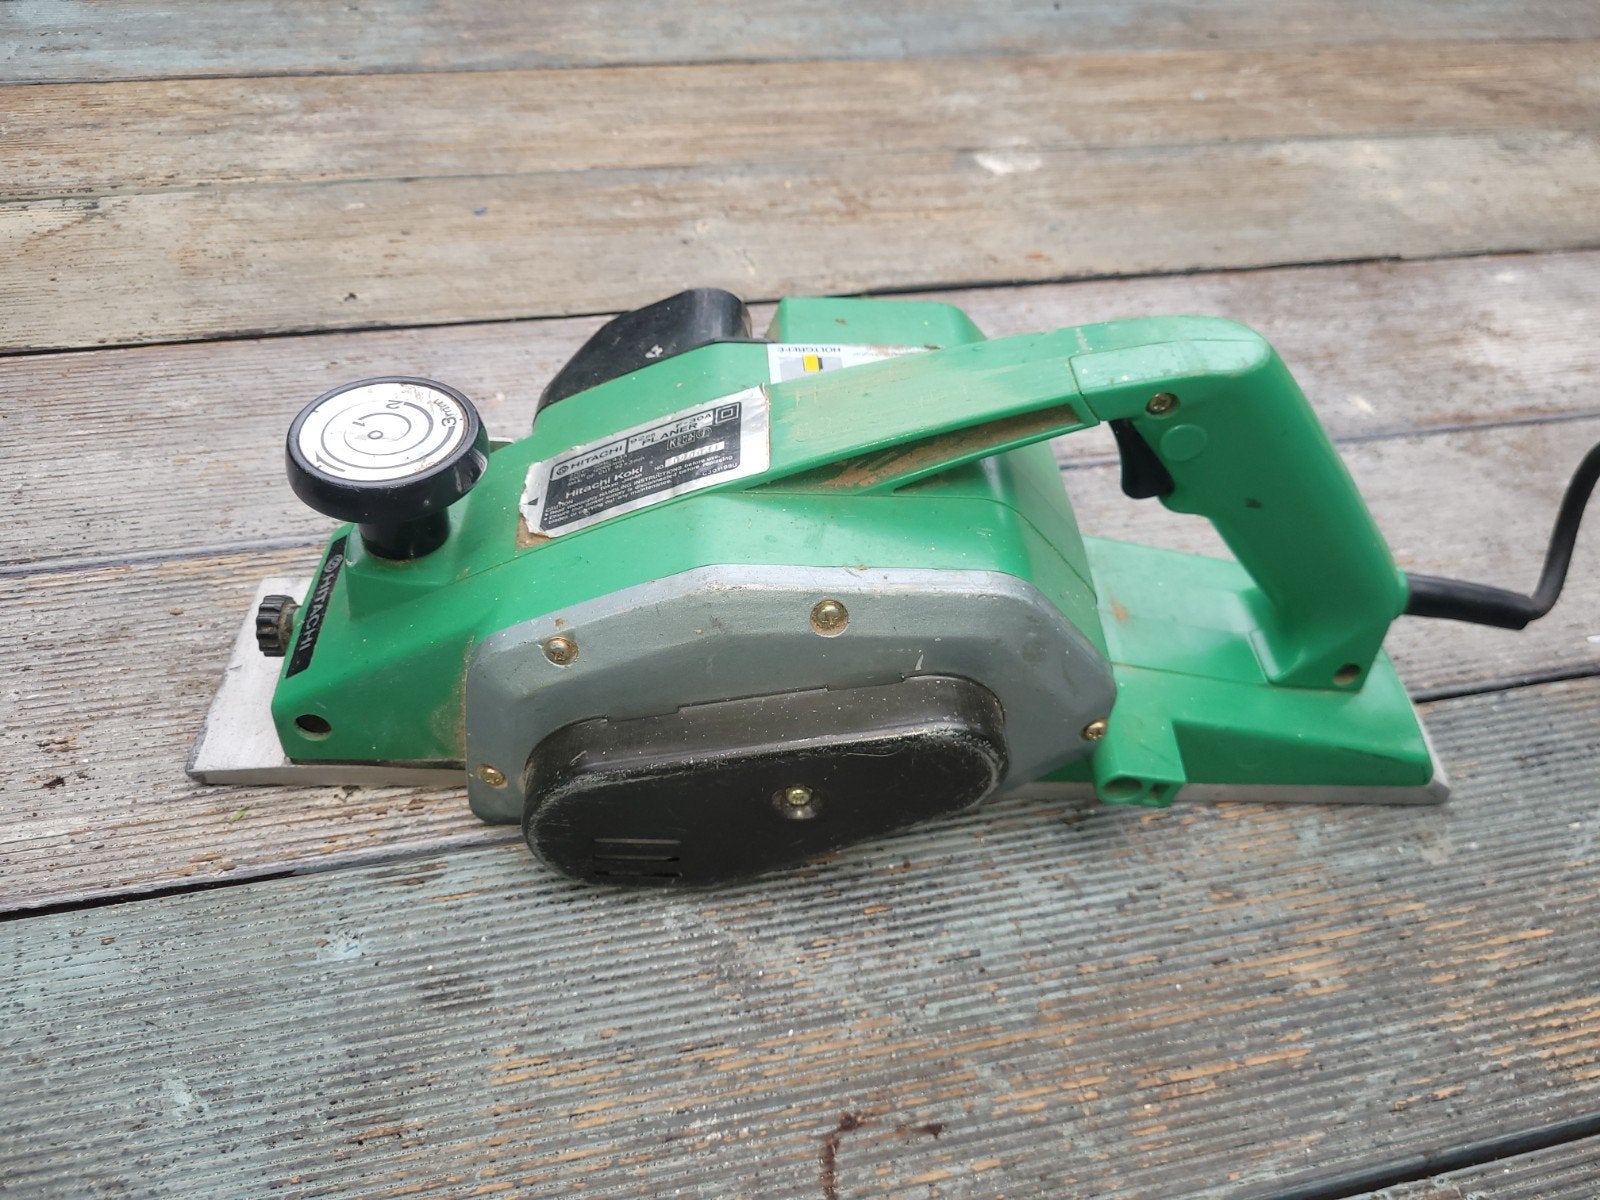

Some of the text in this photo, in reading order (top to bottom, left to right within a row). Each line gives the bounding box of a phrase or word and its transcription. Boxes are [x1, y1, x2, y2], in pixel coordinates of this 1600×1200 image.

[386, 399, 403, 410] 2
[675, 413, 711, 428] F-30A
[642, 423, 698, 446] PLANER
[570, 446, 622, 468] HITACHI
[565, 478, 610, 498] Hitachi
[614, 466, 643, 481] Koki
[634, 466, 682, 486] INSTRUCTIONS
[634, 472, 678, 490] disconnected
[298, 573, 336, 651] HITACHI
